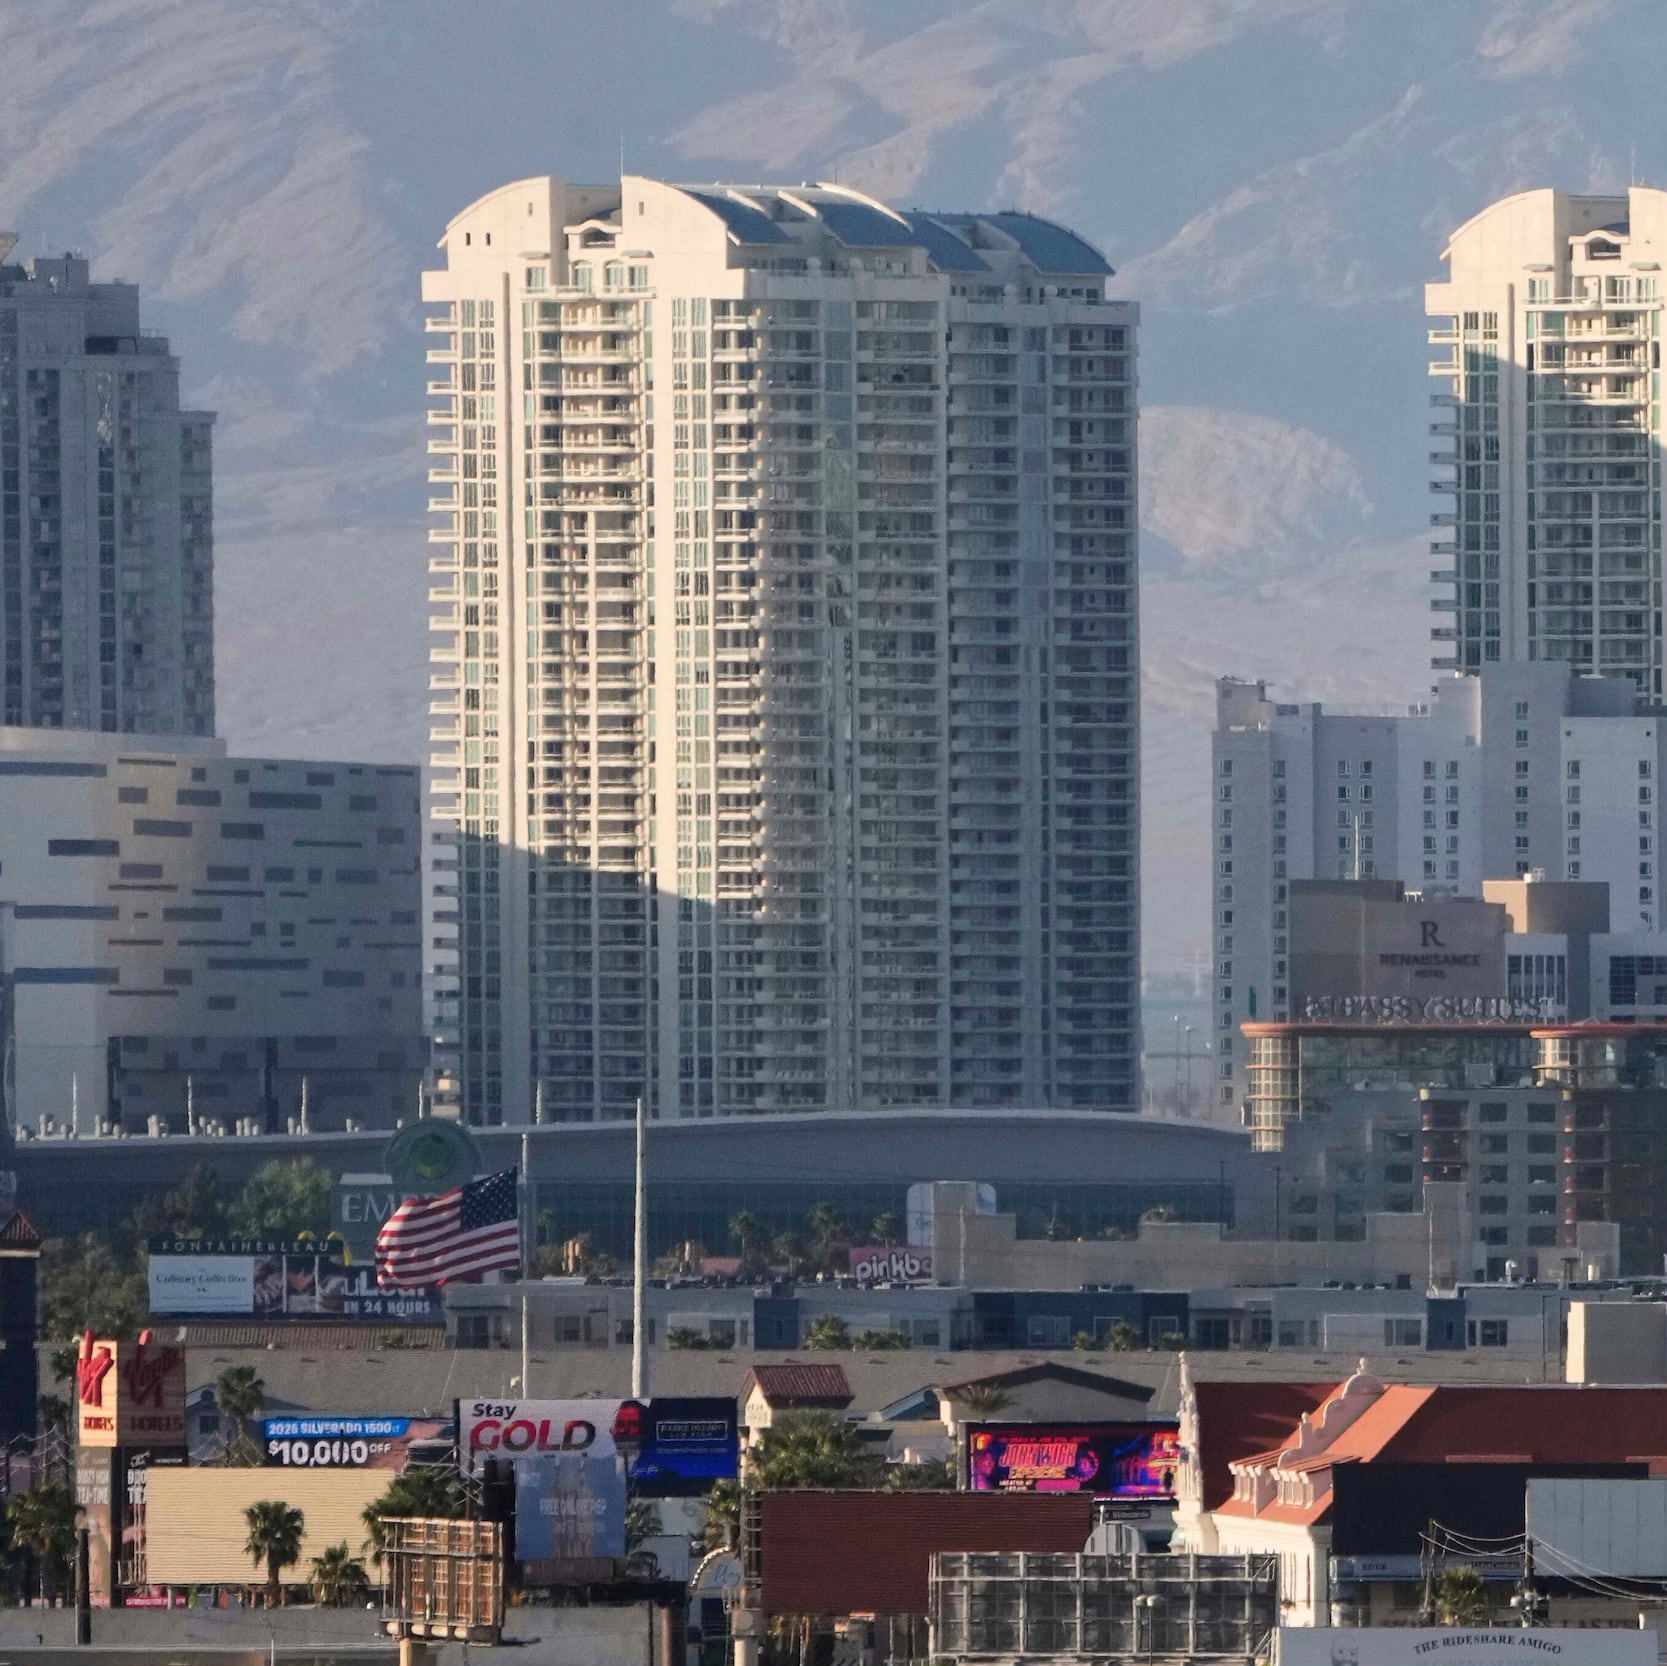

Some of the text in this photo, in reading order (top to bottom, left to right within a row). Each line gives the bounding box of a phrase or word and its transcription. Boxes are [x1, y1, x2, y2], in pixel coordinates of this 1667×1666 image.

[1420, 920, 1445, 947] R
[1380, 953, 1481, 967] RENAISSANCE
[161, 1240, 329, 1253] FONTAINEBLEAU
[197, 1272, 246, 1284] Collection
[364, 1301, 382, 1314] 24
[472, 1402, 517, 1421] Stay
[300, 1421, 363, 1434] SILVERADO
[365, 1421, 392, 1434] 1500
[470, 1419, 596, 1452] GOLD
[268, 1439, 392, 1467] $10,000 OFF
[1413, 1635, 1562, 1656] THE RIDESHARE AMIGO
